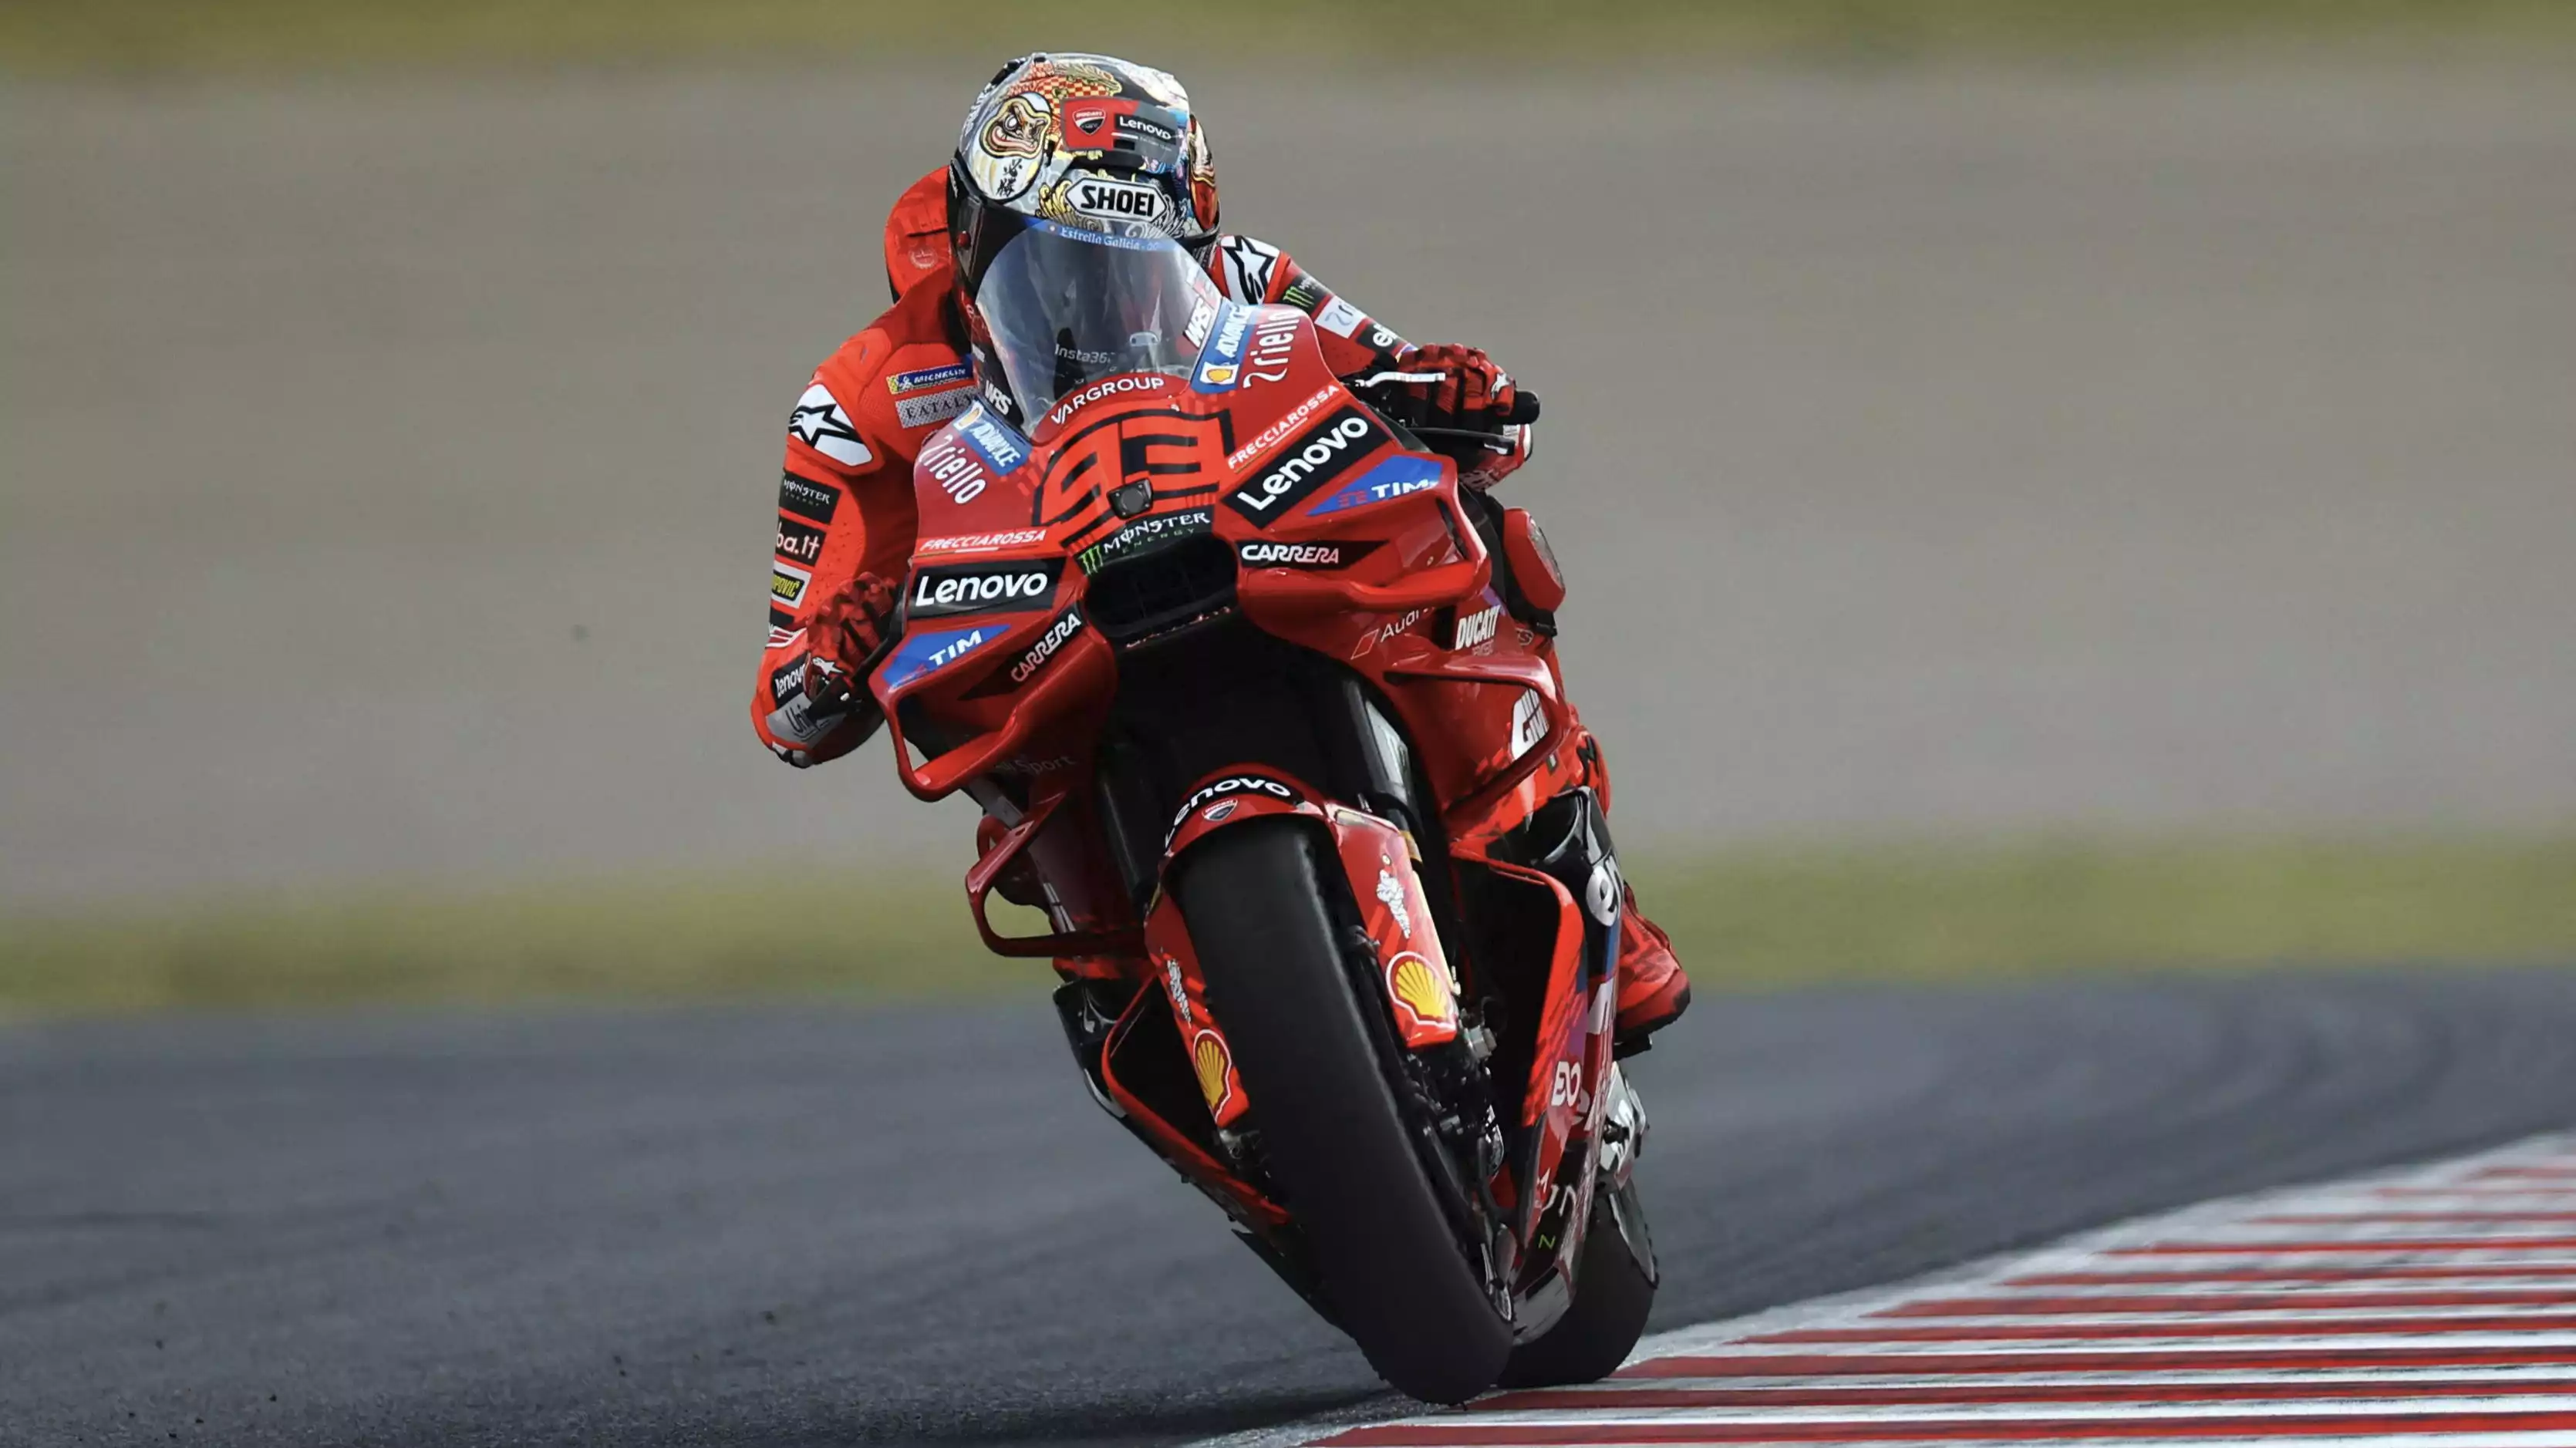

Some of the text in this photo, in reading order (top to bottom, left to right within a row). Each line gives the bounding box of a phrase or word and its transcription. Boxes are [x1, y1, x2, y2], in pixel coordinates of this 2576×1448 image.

[1119, 116, 1172, 140] Lenovo
[1081, 184, 1155, 217] SHOEI
[1060, 227, 1101, 244] Estrella
[1104, 236, 1141, 251] Galicia
[914, 369, 966, 383] MICHELIN
[984, 379, 1013, 416] WRS
[1050, 376, 1165, 425] VARGROUP
[1228, 384, 1340, 470] FRECCIAROSSA
[1033, 408, 1236, 549] 93
[1236, 417, 1369, 511] Lenovo
[1371, 479, 1438, 499] TIM
[919, 530, 1047, 551] FRECCIAROSSA
[1103, 511, 1212, 554] MONSTER
[1241, 544, 1339, 564] CARRERA
[915, 572, 1048, 607] Lenovo
[1455, 604, 1502, 651] DUCATI
[928, 629, 983, 666] TIM
[1010, 612, 1081, 682] CARRERA
